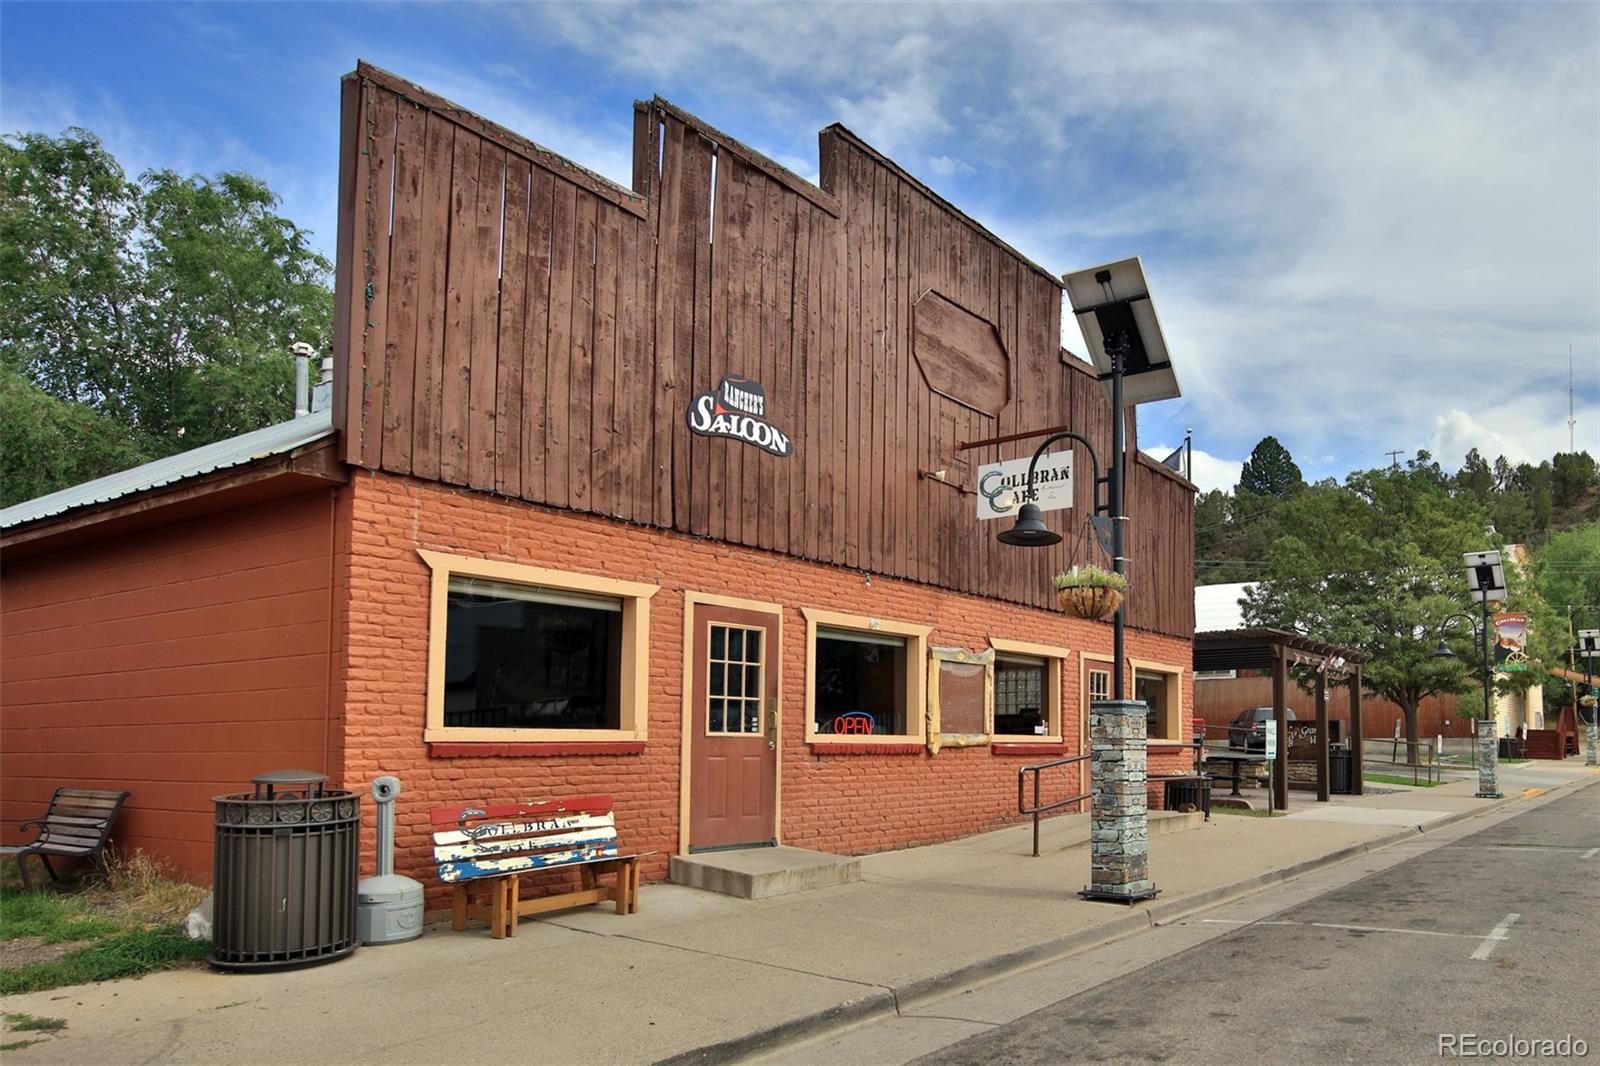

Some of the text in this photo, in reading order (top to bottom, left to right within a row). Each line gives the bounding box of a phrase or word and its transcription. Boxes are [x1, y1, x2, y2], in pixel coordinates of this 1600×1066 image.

[723, 380, 764, 416] RANCHER'S
[690, 395, 790, 453] SALOON
[834, 716, 873, 736] OPEN
